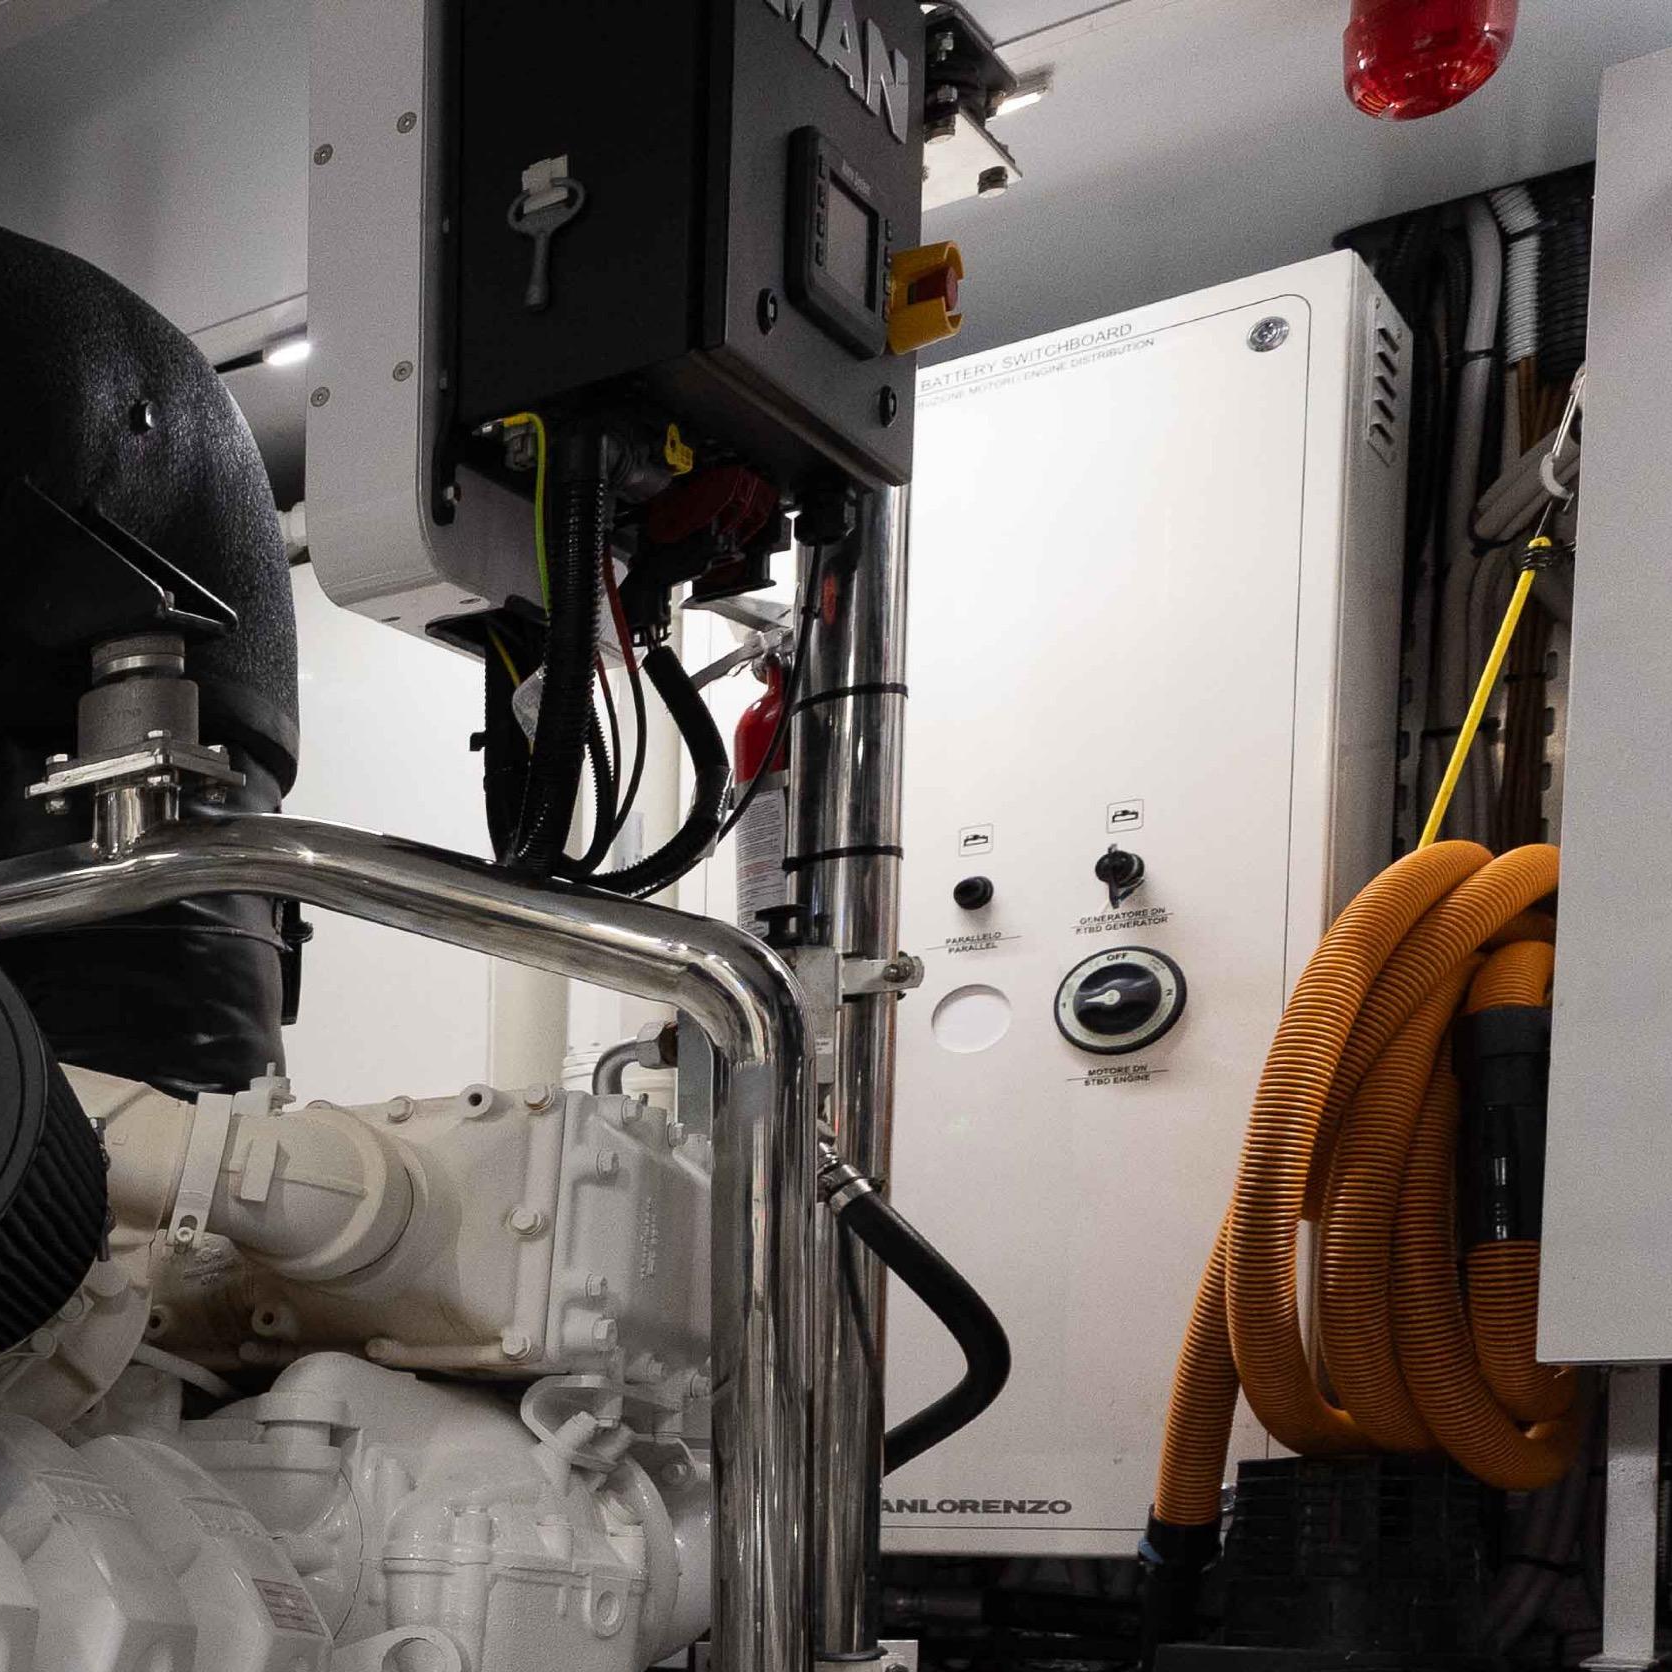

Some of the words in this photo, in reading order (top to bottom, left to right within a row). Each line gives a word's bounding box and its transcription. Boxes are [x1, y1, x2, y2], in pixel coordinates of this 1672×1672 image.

[920, 363, 998, 392] BATTERY
[1001, 323, 1133, 368] SWITCHBOARD
[1024, 361, 1066, 382] ENGINE
[1071, 337, 1155, 370] DISTRIBUTION
[1079, 908, 1148, 925] GENERATORE
[1104, 916, 1169, 931] GENERATOR
[945, 931, 1002, 945] PARALLELO
[948, 941, 998, 954] PARALLEL
[1106, 952, 1128, 962] OFF
[1087, 1065, 1130, 1077] MOTORE
[1084, 1075, 1111, 1087] STBD
[1112, 1073, 1150, 1085] ENGINE
[881, 1499, 1072, 1514] ANLORENZO
